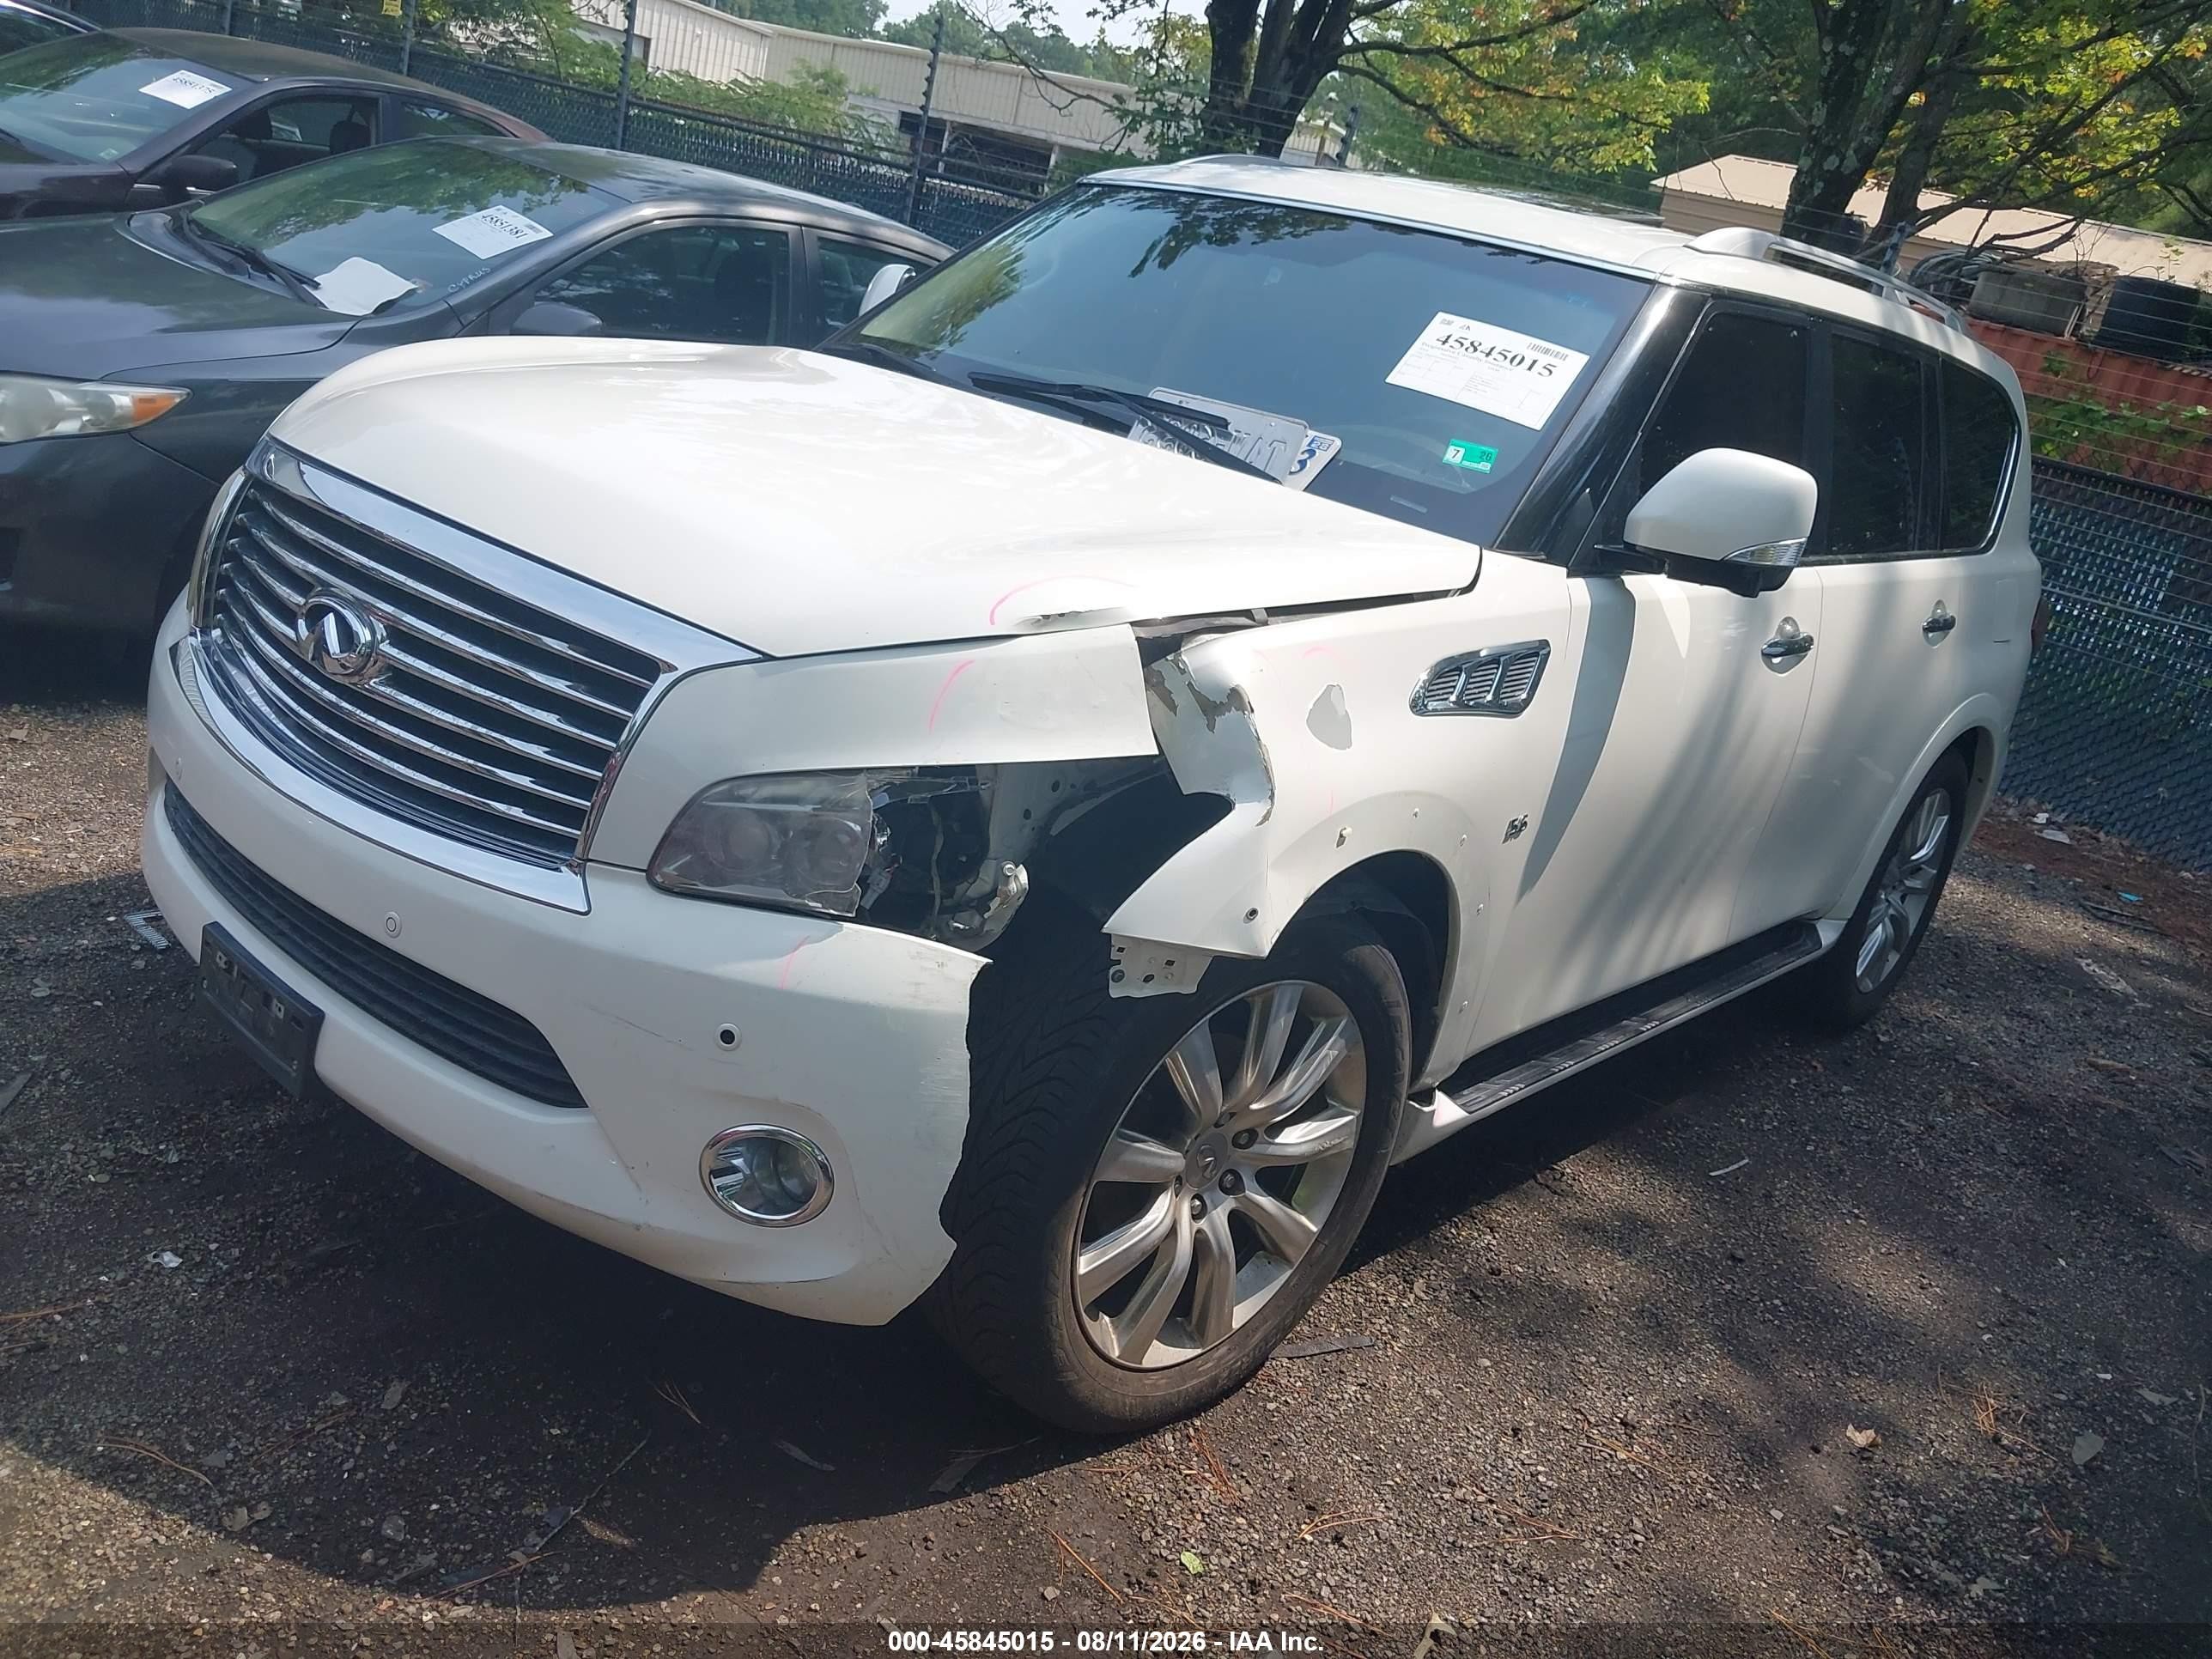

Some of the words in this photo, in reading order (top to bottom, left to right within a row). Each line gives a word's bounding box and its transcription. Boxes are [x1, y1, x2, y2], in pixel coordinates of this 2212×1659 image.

[481, 214, 529, 239] 45851381
[1436, 333, 1559, 378] 45845015
[1451, 448, 1461, 459] 7
